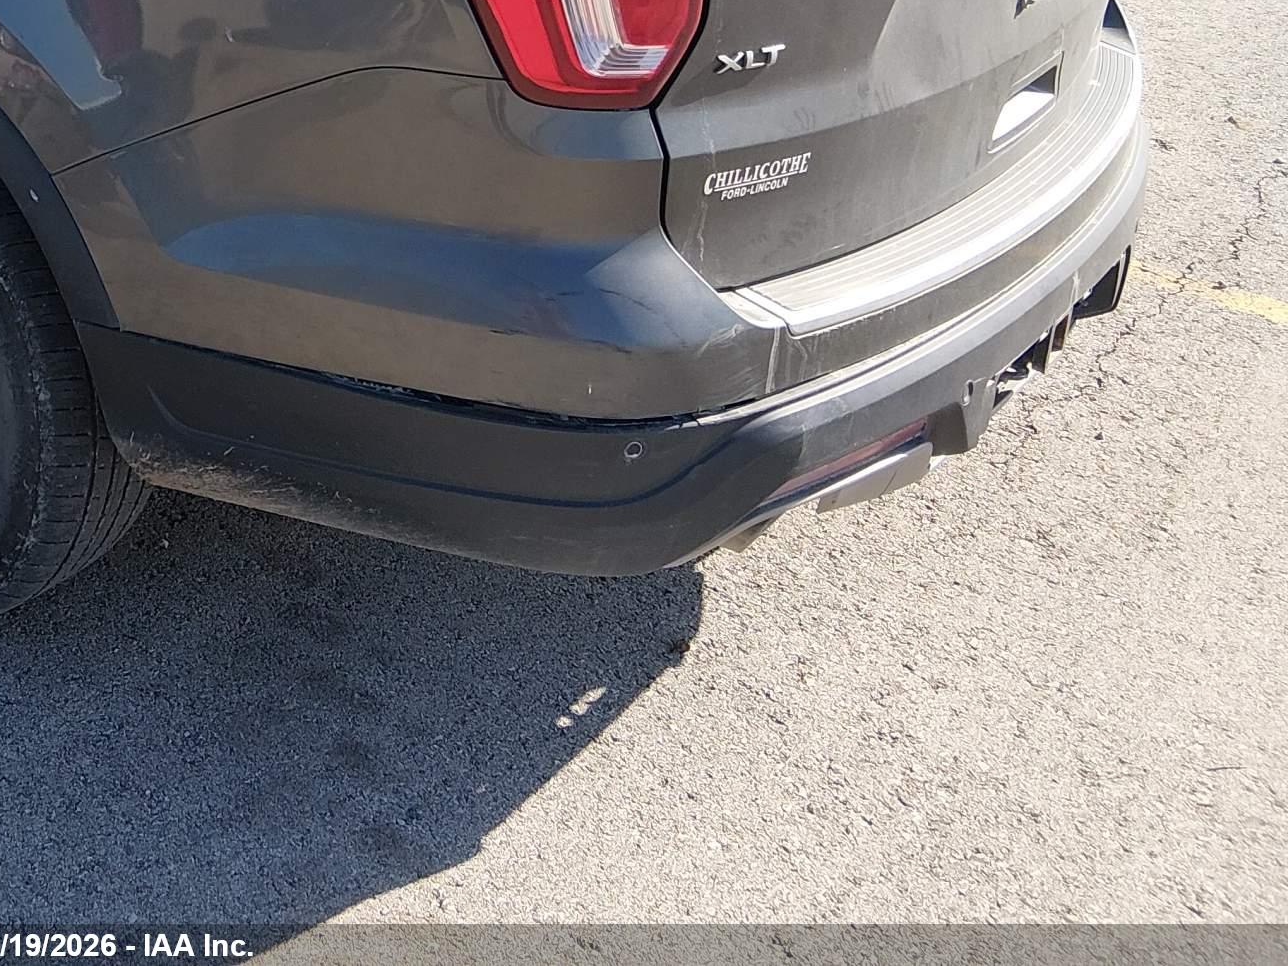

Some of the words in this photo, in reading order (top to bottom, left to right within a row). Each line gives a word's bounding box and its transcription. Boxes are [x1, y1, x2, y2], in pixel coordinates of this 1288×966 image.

[715, 44, 786, 74] XLT
[704, 152, 811, 195] CHILLICOTHE
[721, 177, 789, 200] FORD-LINCOLN
